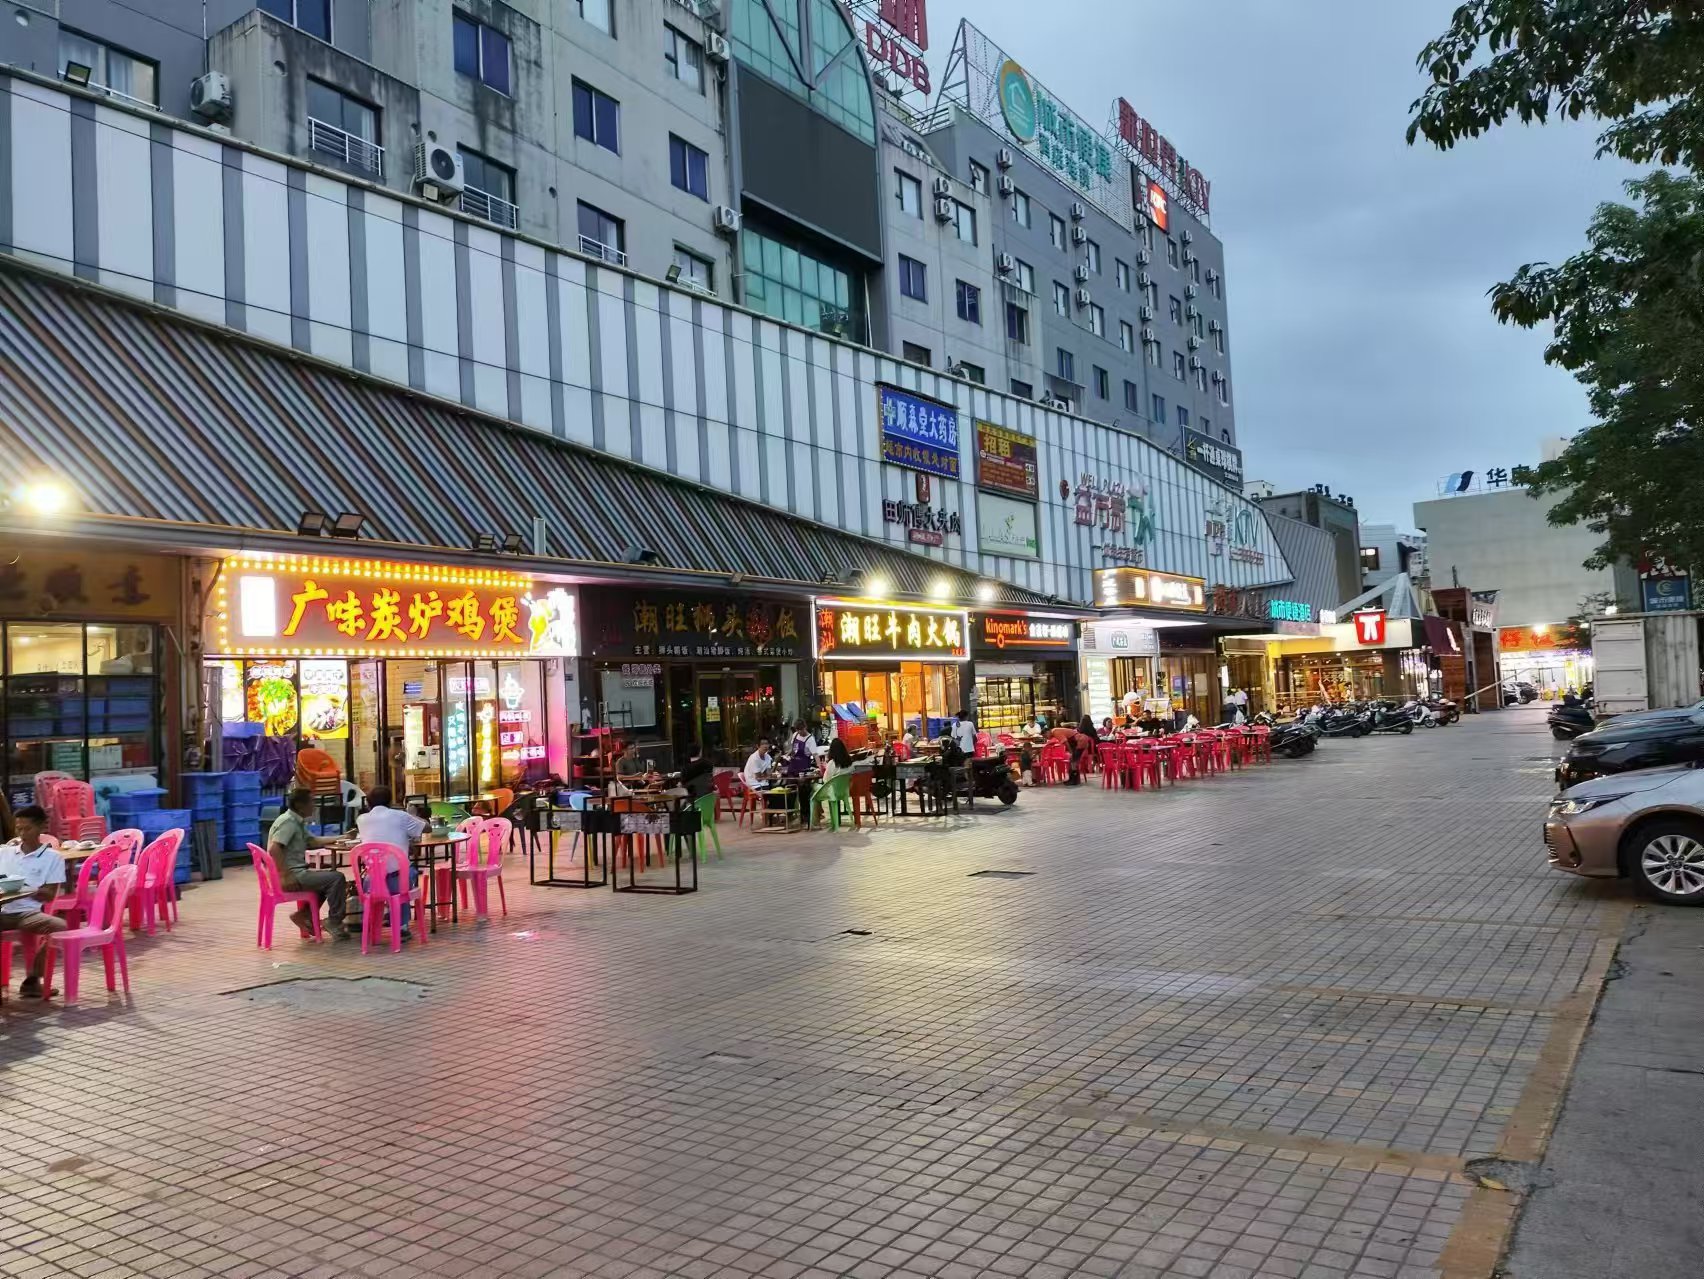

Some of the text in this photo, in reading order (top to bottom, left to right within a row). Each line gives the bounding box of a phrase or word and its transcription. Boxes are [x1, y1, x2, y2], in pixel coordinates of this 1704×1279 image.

[983, 434, 1011, 458] 招租
[282, 579, 523, 644] 广味炭炉鸡煲
[819, 607, 835, 650] 潮汕
[841, 611, 961, 650] 潮旺牛肉火锅
